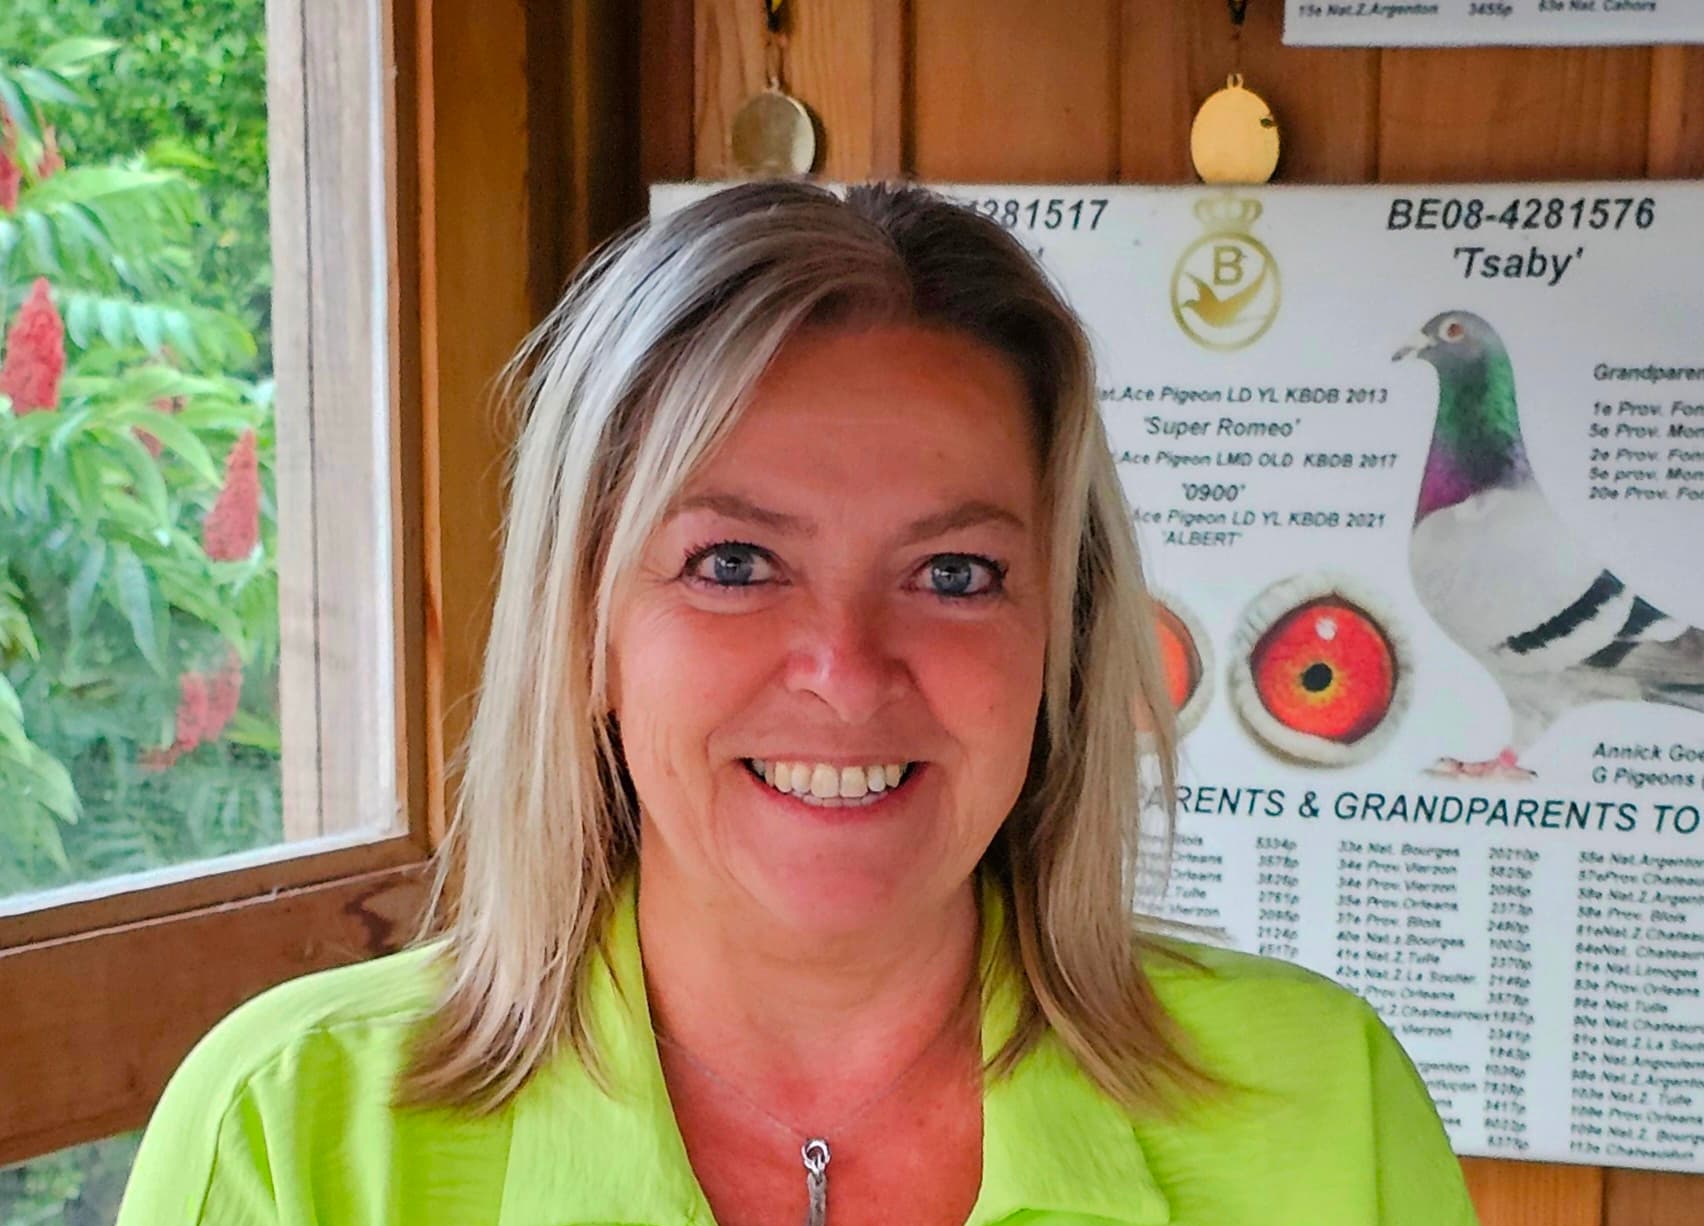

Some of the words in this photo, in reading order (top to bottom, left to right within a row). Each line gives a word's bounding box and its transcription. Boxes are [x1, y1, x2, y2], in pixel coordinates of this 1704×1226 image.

[1387, 199, 1656, 231] BE08-4281576
[1212, 245, 1245, 286] B
[1160, 386, 1221, 404] Pigeon
[1226, 388, 1251, 401] LD
[1607, 767, 1695, 788] Pigeons
[1144, 786, 1285, 817] ARENTS
[1298, 792, 1320, 817] &
[1334, 793, 1637, 832] GRANDPARENTS
